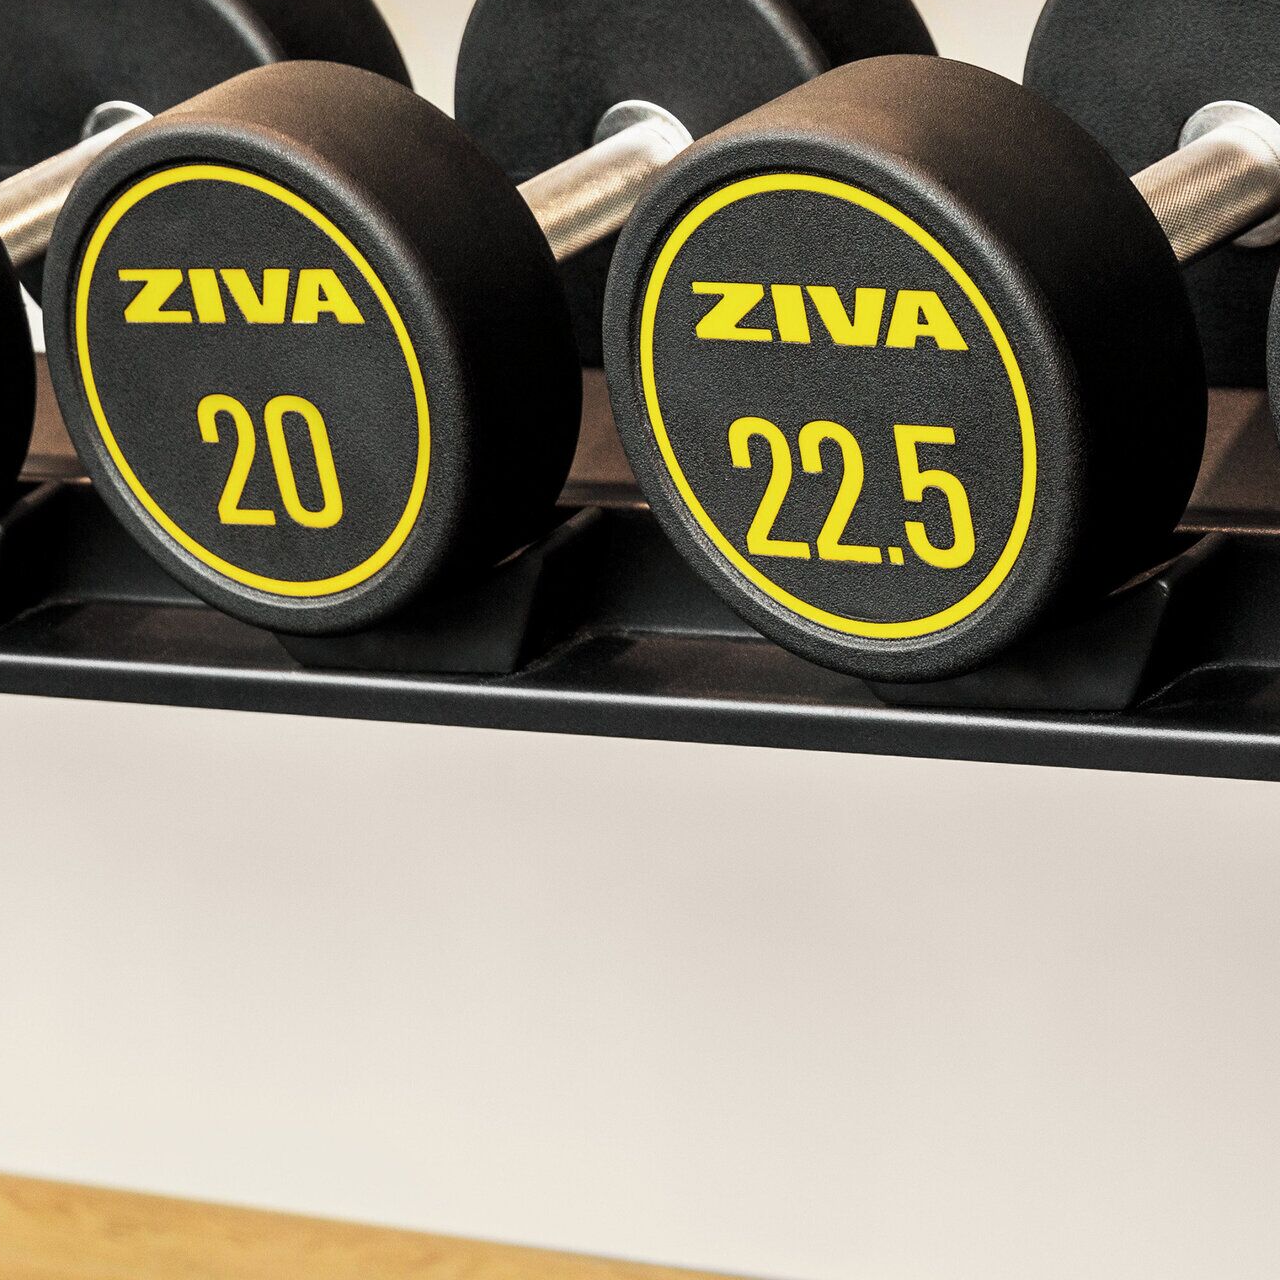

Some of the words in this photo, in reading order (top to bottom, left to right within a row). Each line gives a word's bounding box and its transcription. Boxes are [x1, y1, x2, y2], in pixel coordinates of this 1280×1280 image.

[117, 267, 366, 325] ZIVA
[691, 280, 970, 352] ZIVA
[196, 393, 344, 530] 20
[727, 416, 977, 570] 22.5
